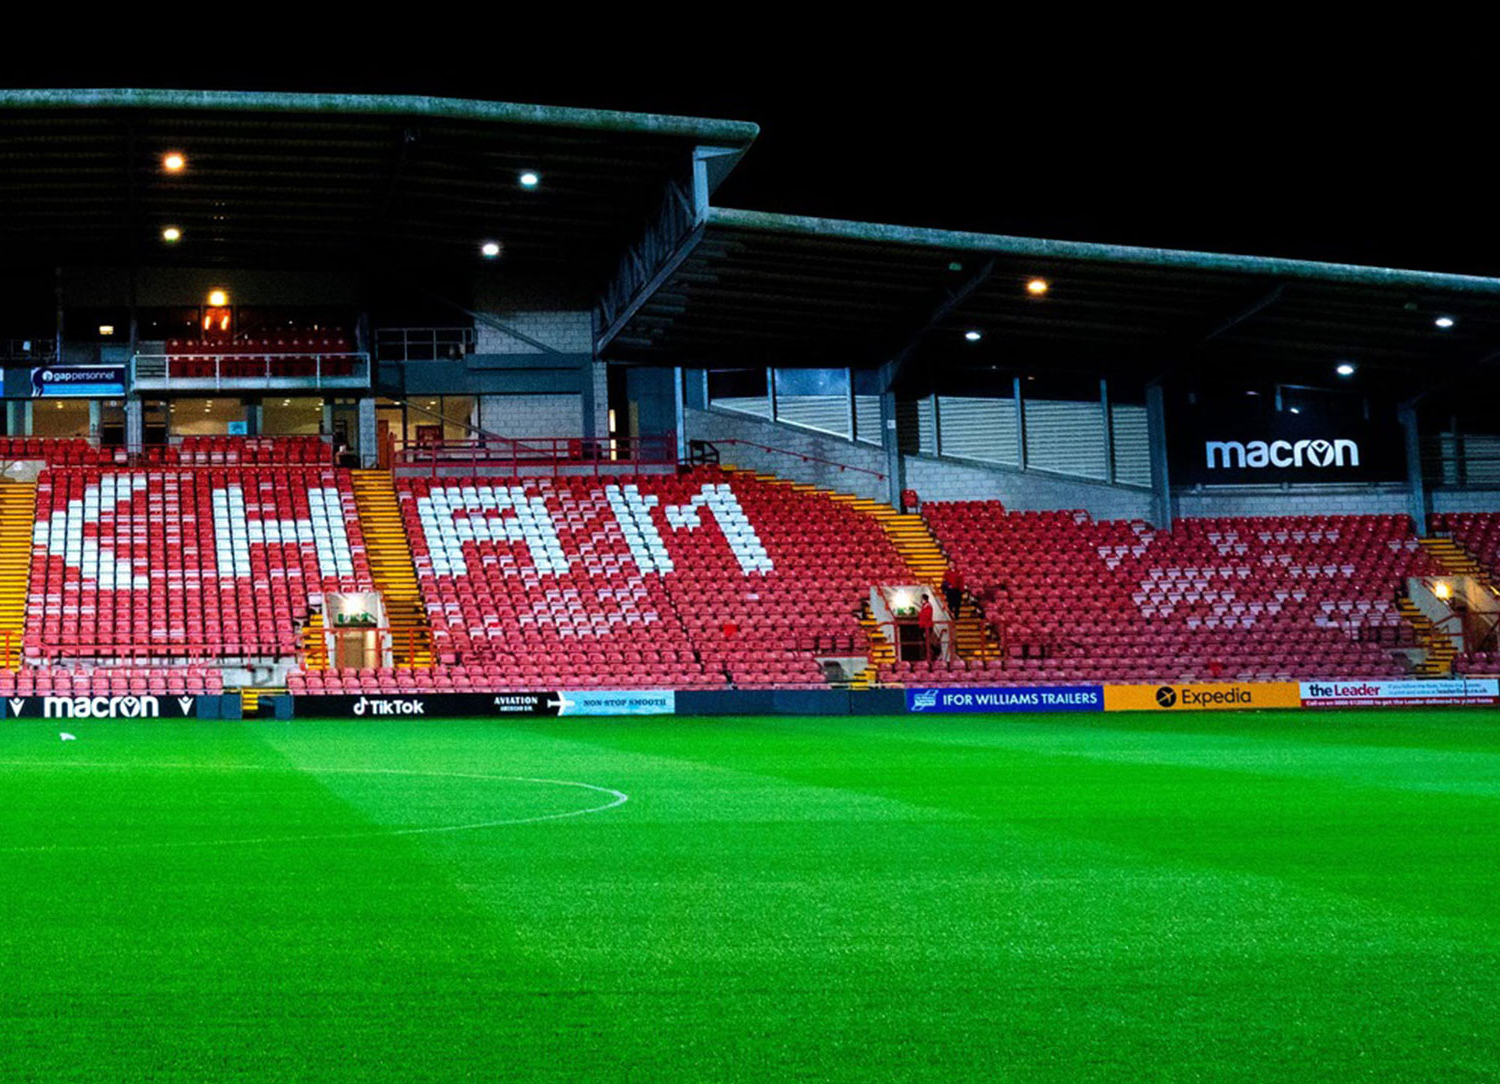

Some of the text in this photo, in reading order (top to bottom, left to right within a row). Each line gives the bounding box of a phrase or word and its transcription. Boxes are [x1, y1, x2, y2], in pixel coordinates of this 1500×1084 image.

[1205, 439, 1359, 468] macron
[1182, 688, 1252, 706] Expedia
[1309, 684, 1332, 696] the
[1334, 684, 1380, 696] Leader
[370, 699, 424, 714] TikTok
[494, 696, 538, 705] AVIATION
[943, 692, 1097, 706] IFOR WILLIAMS TRAILERS
[44, 696, 159, 718] macron
